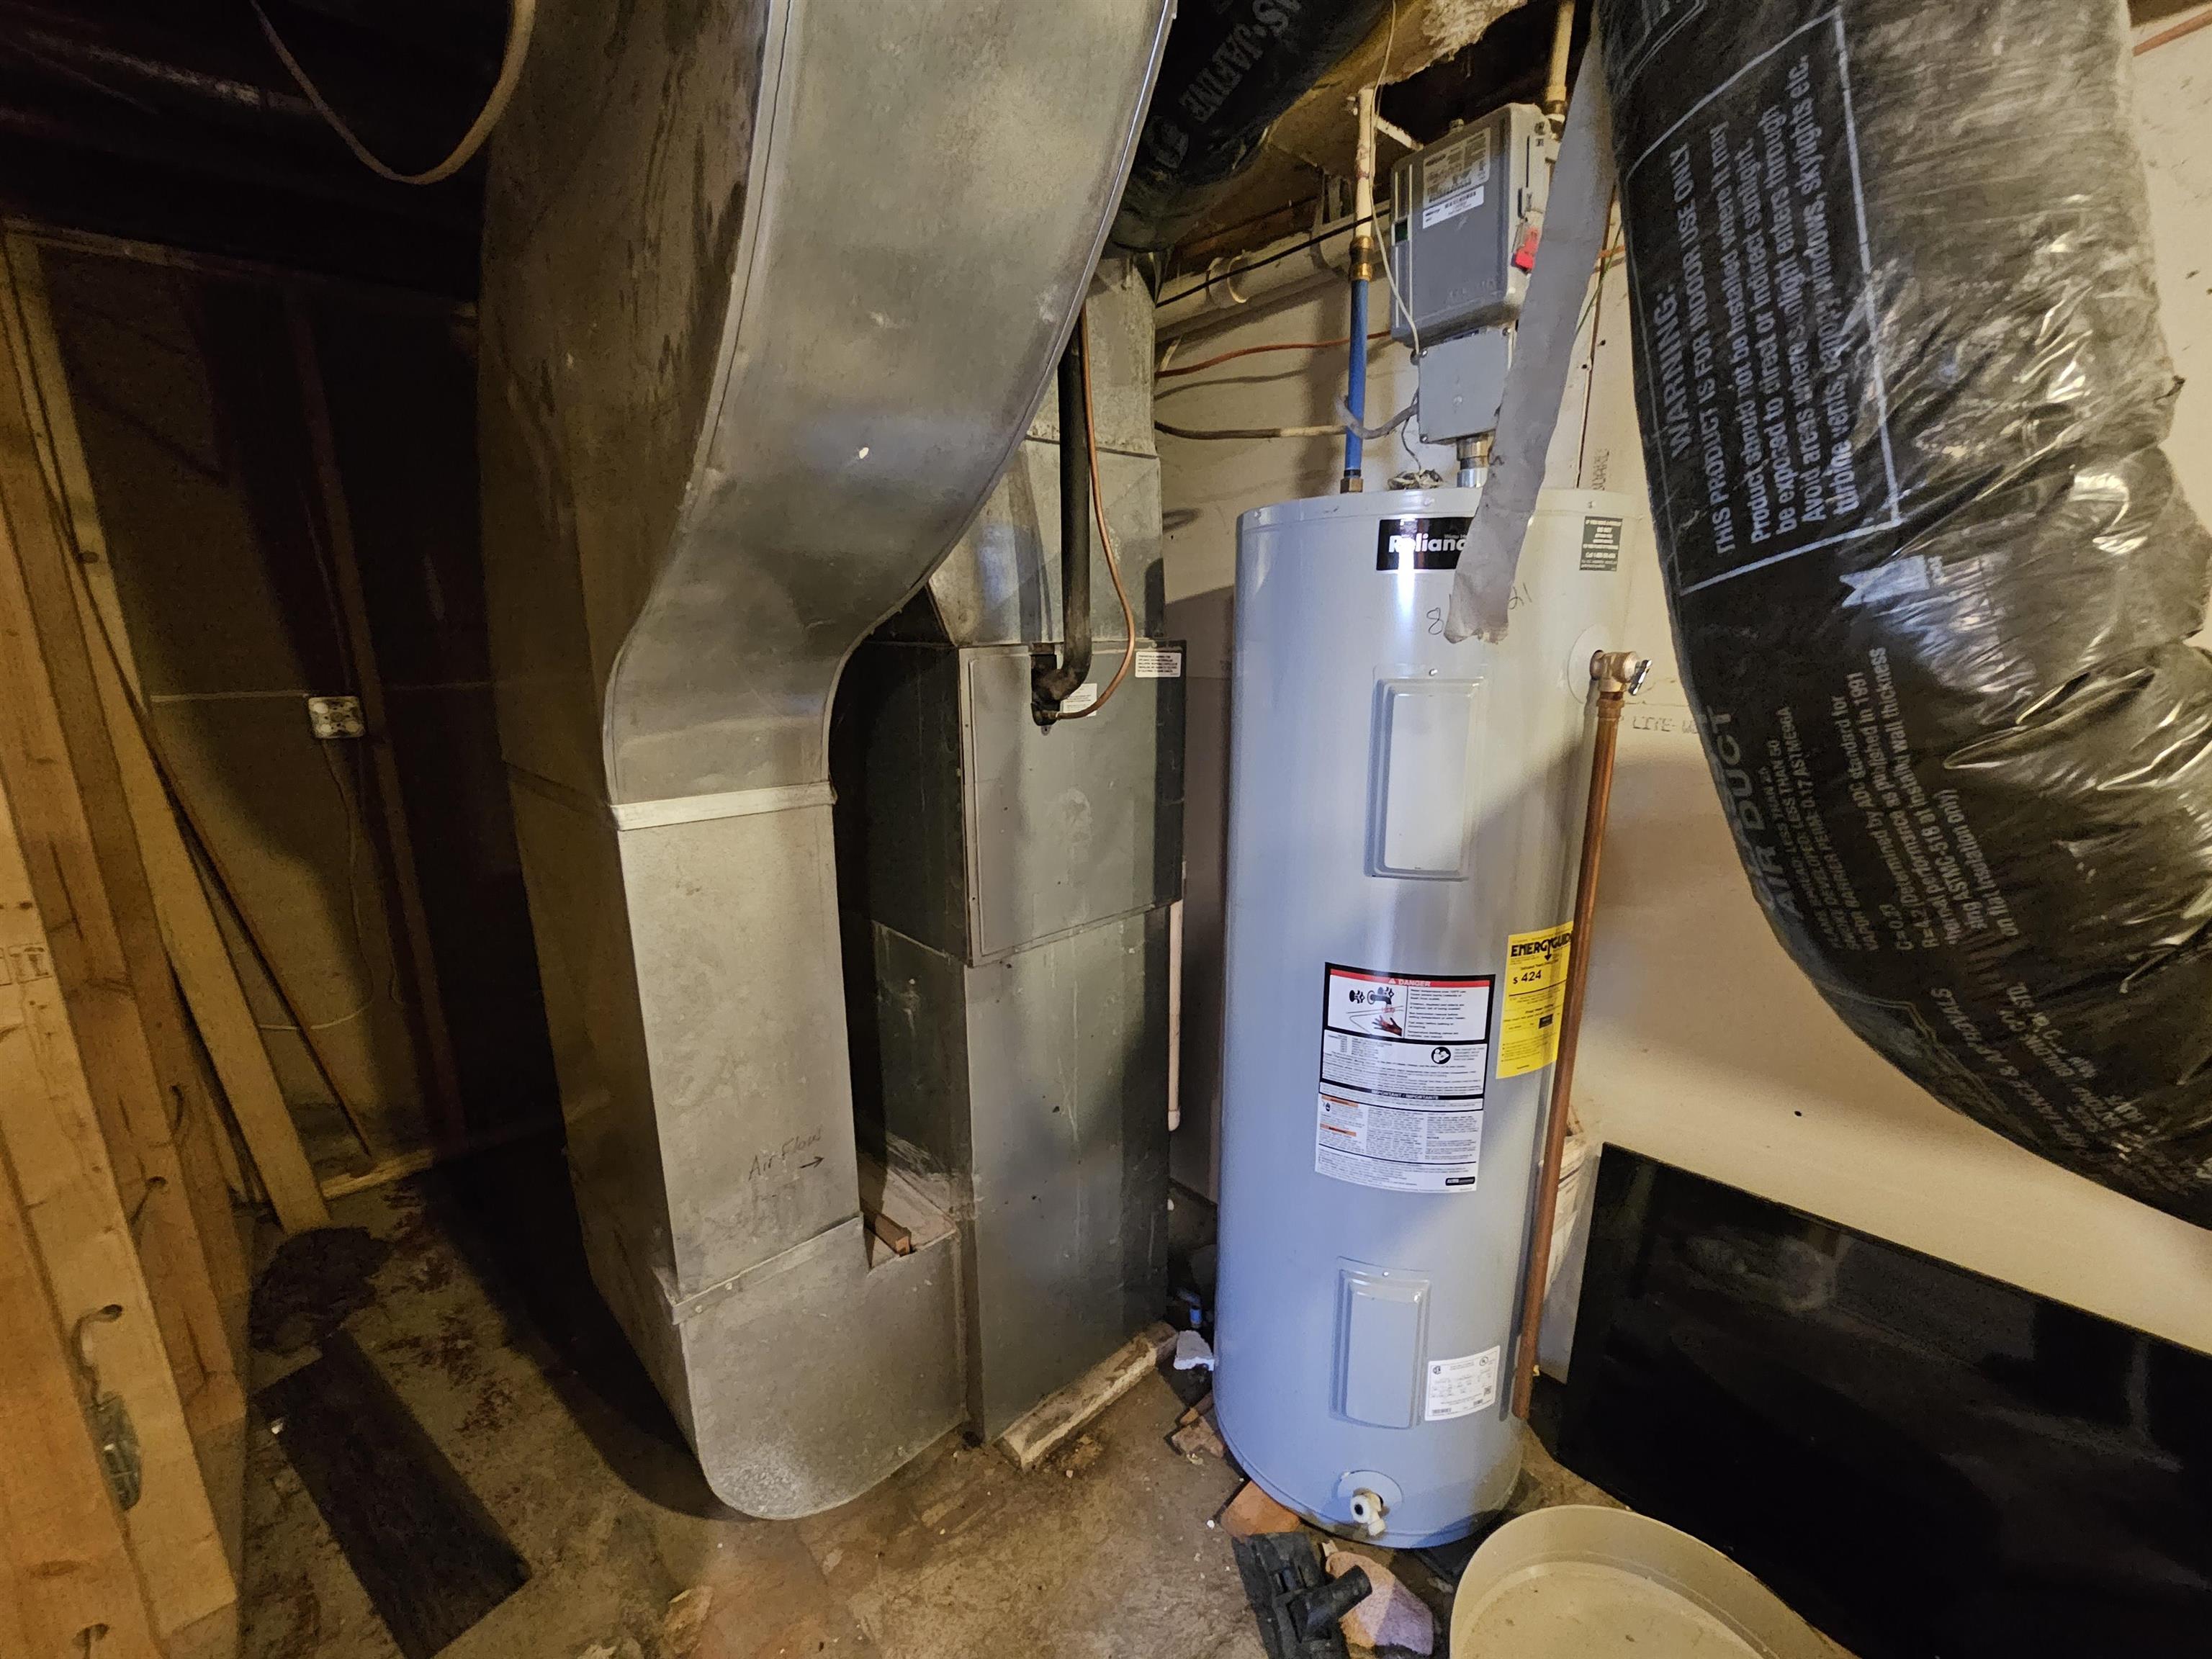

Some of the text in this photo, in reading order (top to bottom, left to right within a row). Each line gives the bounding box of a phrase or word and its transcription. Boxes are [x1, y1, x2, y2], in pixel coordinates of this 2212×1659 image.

[1786, 55, 1859, 514] turbine vents, canopy windows, skylights etc.
[1758, 104, 1826, 522] Avoid areas where sunlight enters through
[1670, 143, 1735, 553] THIS PRODUCT IS FOR INDOOR USE ONLY
[1709, 121, 1771, 542] Product should not be installed where it may
[1735, 138, 1798, 534] be exposed to direct or indirect sunlight.
[1654, 285, 1691, 456] WARNING:
[1389, 533, 1467, 553] Relianc
[1846, 672, 1868, 705] 1991
[1869, 647, 1898, 719] thickness
[1831, 696, 1848, 716] for
[1858, 709, 1875, 724] in
[1835, 719, 1866, 779] standard
[1885, 720, 1908, 753] wall
[1861, 726, 1894, 791] published
[1772, 760, 1792, 794] THAN
[1709, 709, 1803, 917] AIR DUCT
[1782, 797, 1803, 829] LESS
[1849, 784, 1874, 807] ADC
[1882, 792, 1899, 807] as
[1933, 789, 1964, 824] only)
[1866, 811, 1883, 829] by
[1915, 809, 1936, 824] at
[1890, 811, 1941, 894] performance
[1922, 826, 1969, 900] ASTMC-518
[1954, 824, 1996, 890] insulation
[1851, 912, 1879, 950] VAPOR
[1997, 918, 2019, 936] on
[1511, 932, 1572, 961] ENERGYGUID
[1521, 969, 1542, 982] 424
